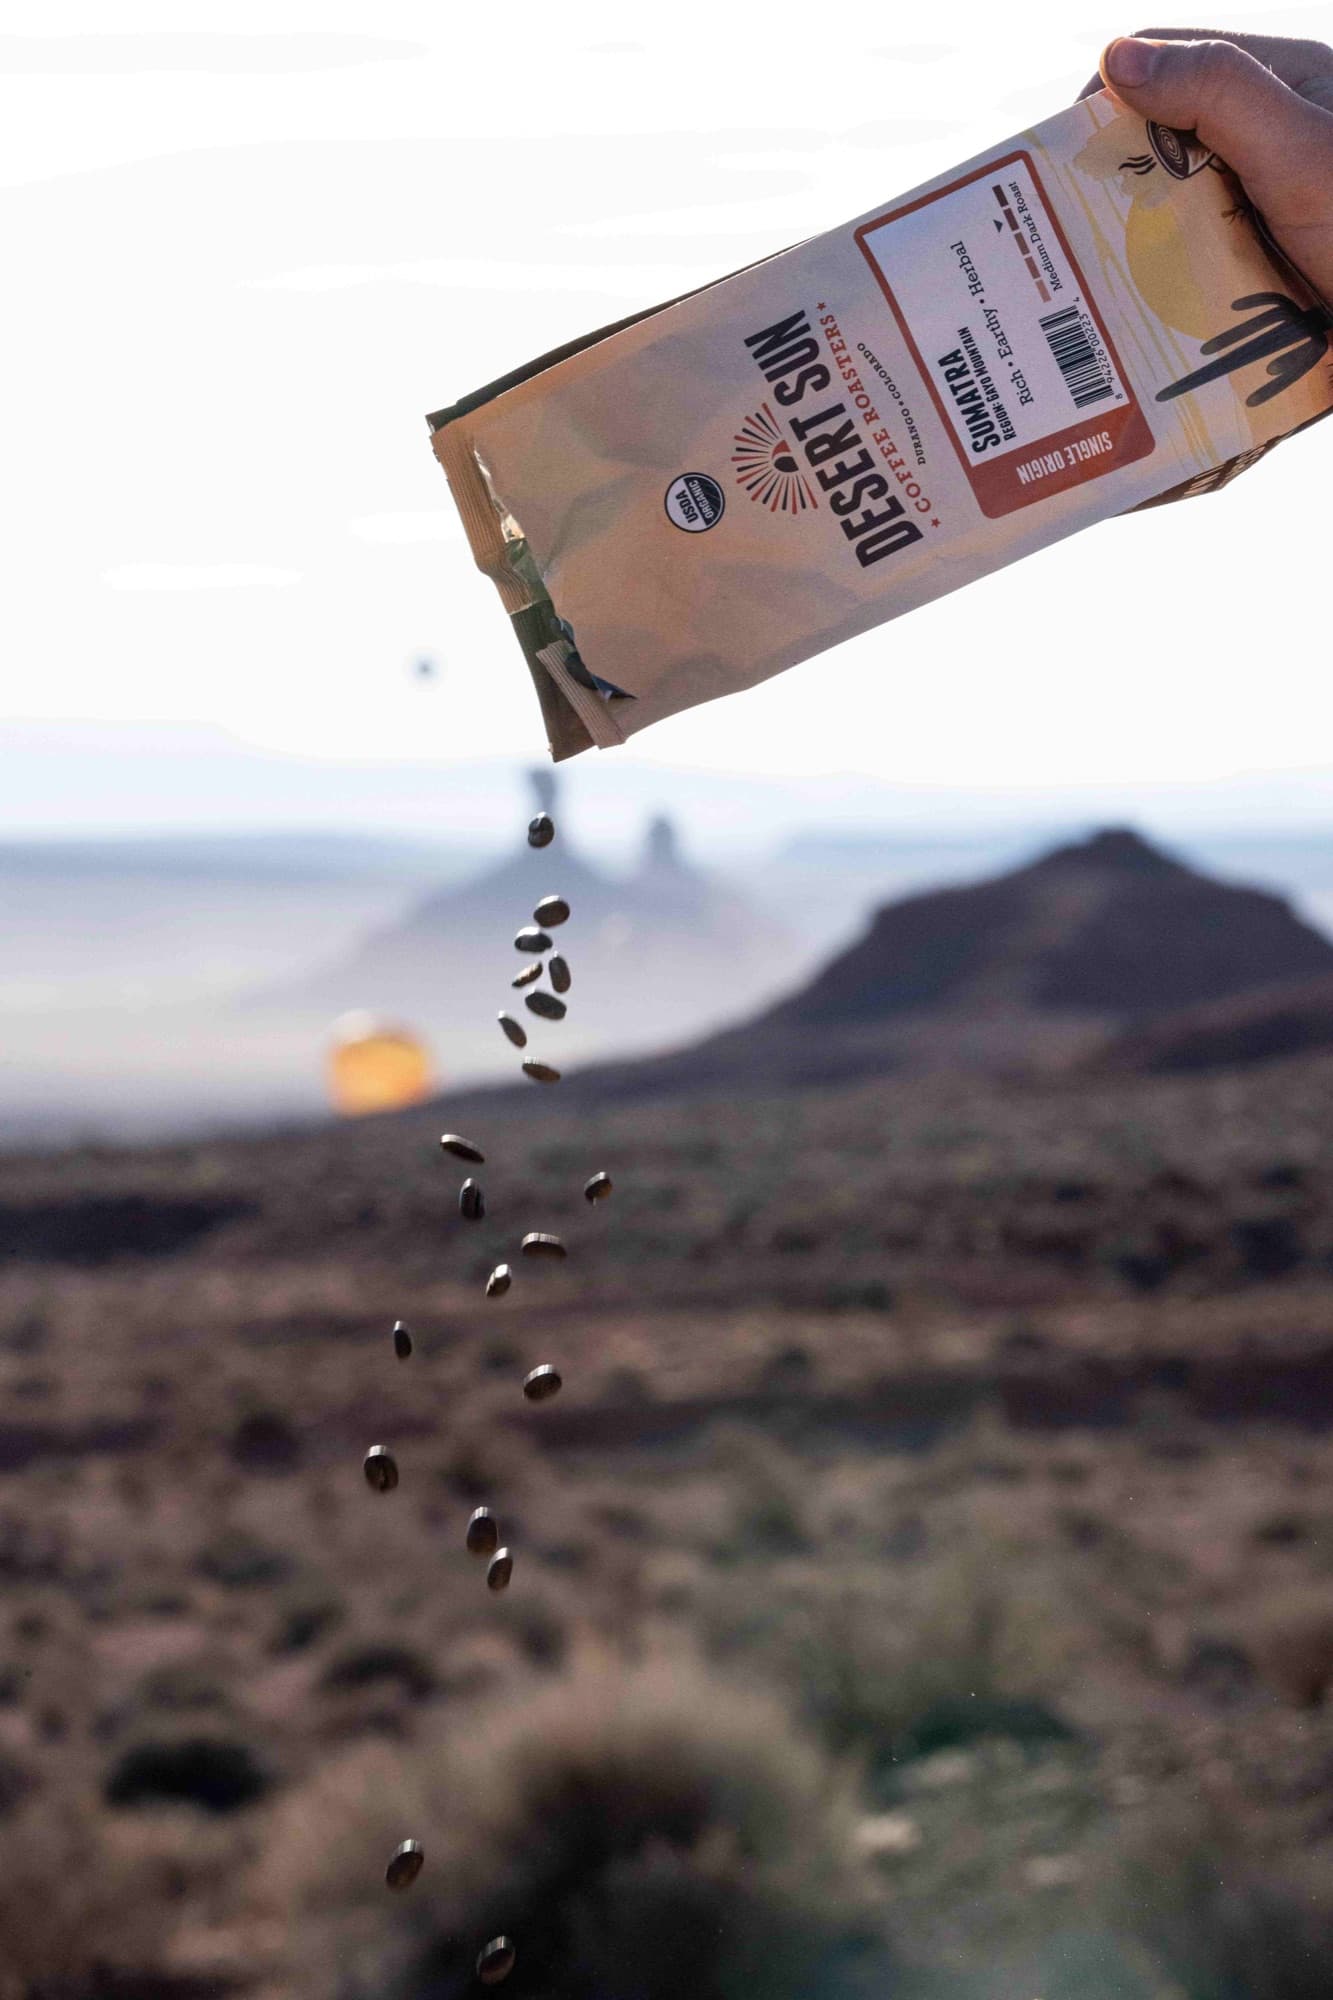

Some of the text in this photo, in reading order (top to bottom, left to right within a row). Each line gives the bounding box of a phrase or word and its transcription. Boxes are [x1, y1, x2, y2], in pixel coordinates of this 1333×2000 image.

[1008, 181, 1063, 292] Medium Dark Roast
[949, 240, 1035, 407] Rich Earthy Herbal
[743, 310, 924, 568] DESERT SUN
[819, 314, 932, 513] COFFEE ROASTERS
[856, 342, 926, 466] DURANGO COLORADO
[937, 348, 1001, 454] SUMATRA
[957, 326, 1017, 441] REGION: GAYO MOUNTAIN
[675, 489, 699, 524] USDA
[688, 480, 714, 519] ORGANIC
[1016, 431, 1113, 485] SINGLE ORIGIN
